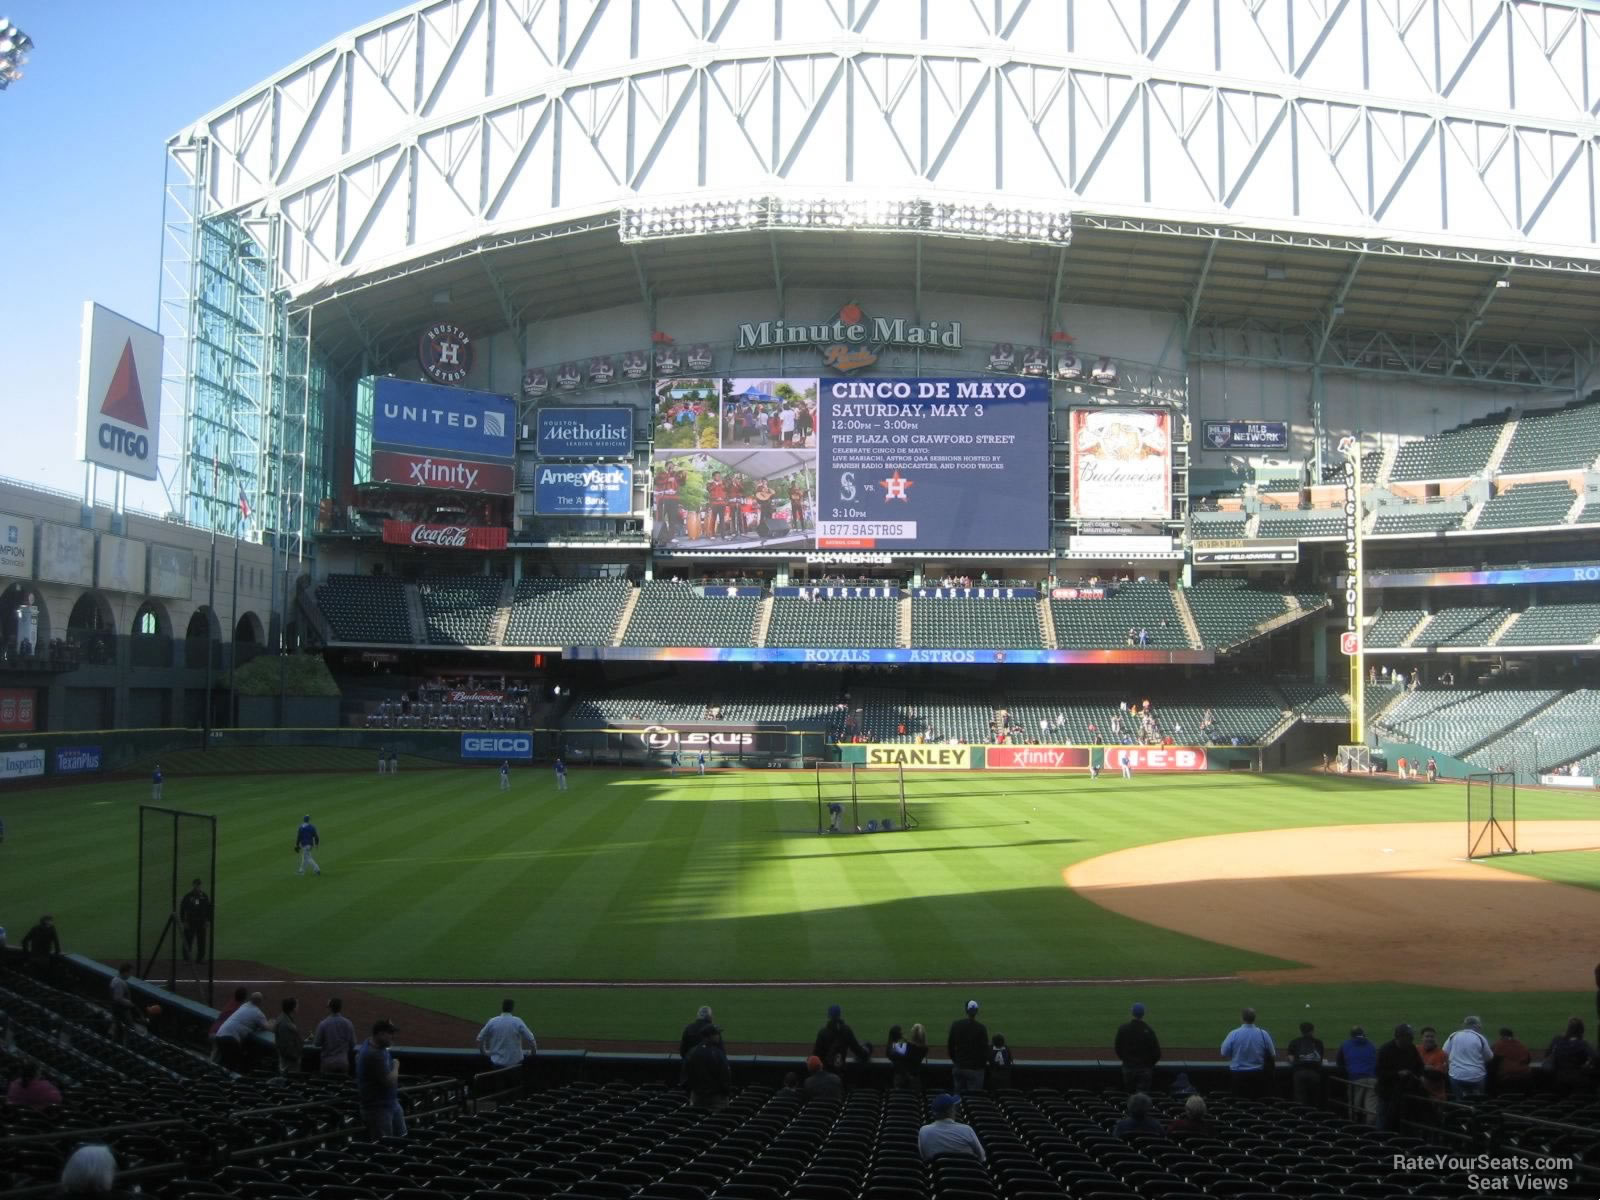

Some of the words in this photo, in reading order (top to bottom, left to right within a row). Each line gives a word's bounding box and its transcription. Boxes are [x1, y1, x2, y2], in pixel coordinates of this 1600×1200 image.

[428, 325, 469, 344] HOUSTON
[739, 320, 865, 348] Minute
[873, 317, 962, 348] Maid
[440, 342, 459, 364] H
[429, 365, 466, 381] ASTROS
[832, 383, 911, 398] CINCO
[918, 383, 950, 398] DE
[957, 383, 1026, 398] MAYO
[384, 403, 477, 428] UNITED
[832, 404, 926, 418] SATURDAY,
[930, 404, 969, 416] MAY
[974, 404, 984, 416] 3
[544, 424, 627, 440] Methodist
[832, 420, 871, 429] 12:00PM
[884, 420, 918, 429] 3:00PM
[1248, 425, 1267, 433] MLB
[99, 423, 149, 460] CITGO
[832, 435, 853, 443] THE
[856, 435, 889, 443] PLAZA
[892, 435, 908, 443] ON
[911, 435, 973, 443] CRAWFORD
[976, 435, 1015, 443] STREET
[1233, 432, 1280, 441] NETWORK
[410, 459, 478, 489] xfinity
[1080, 461, 1162, 482] Budweiser
[832, 509, 866, 517] 3:10PM
[799, 587, 890, 599] HOUSTON
[936, 588, 1013, 598] ASTROS
[1346, 575, 1357, 631] FOUL
[806, 650, 870, 662] ROYALS
[910, 650, 975, 662] ASTROS
[452, 691, 503, 702] Budweiser
[464, 738, 529, 752] GEICO
[674, 733, 752, 745] LEXUS
[6, 755, 42, 773] Insperity
[58, 752, 99, 770] TexanPlus
[871, 749, 965, 765] STANLEY
[1013, 749, 1064, 767] xfinity
[1117, 750, 1196, 767] H-E-B
